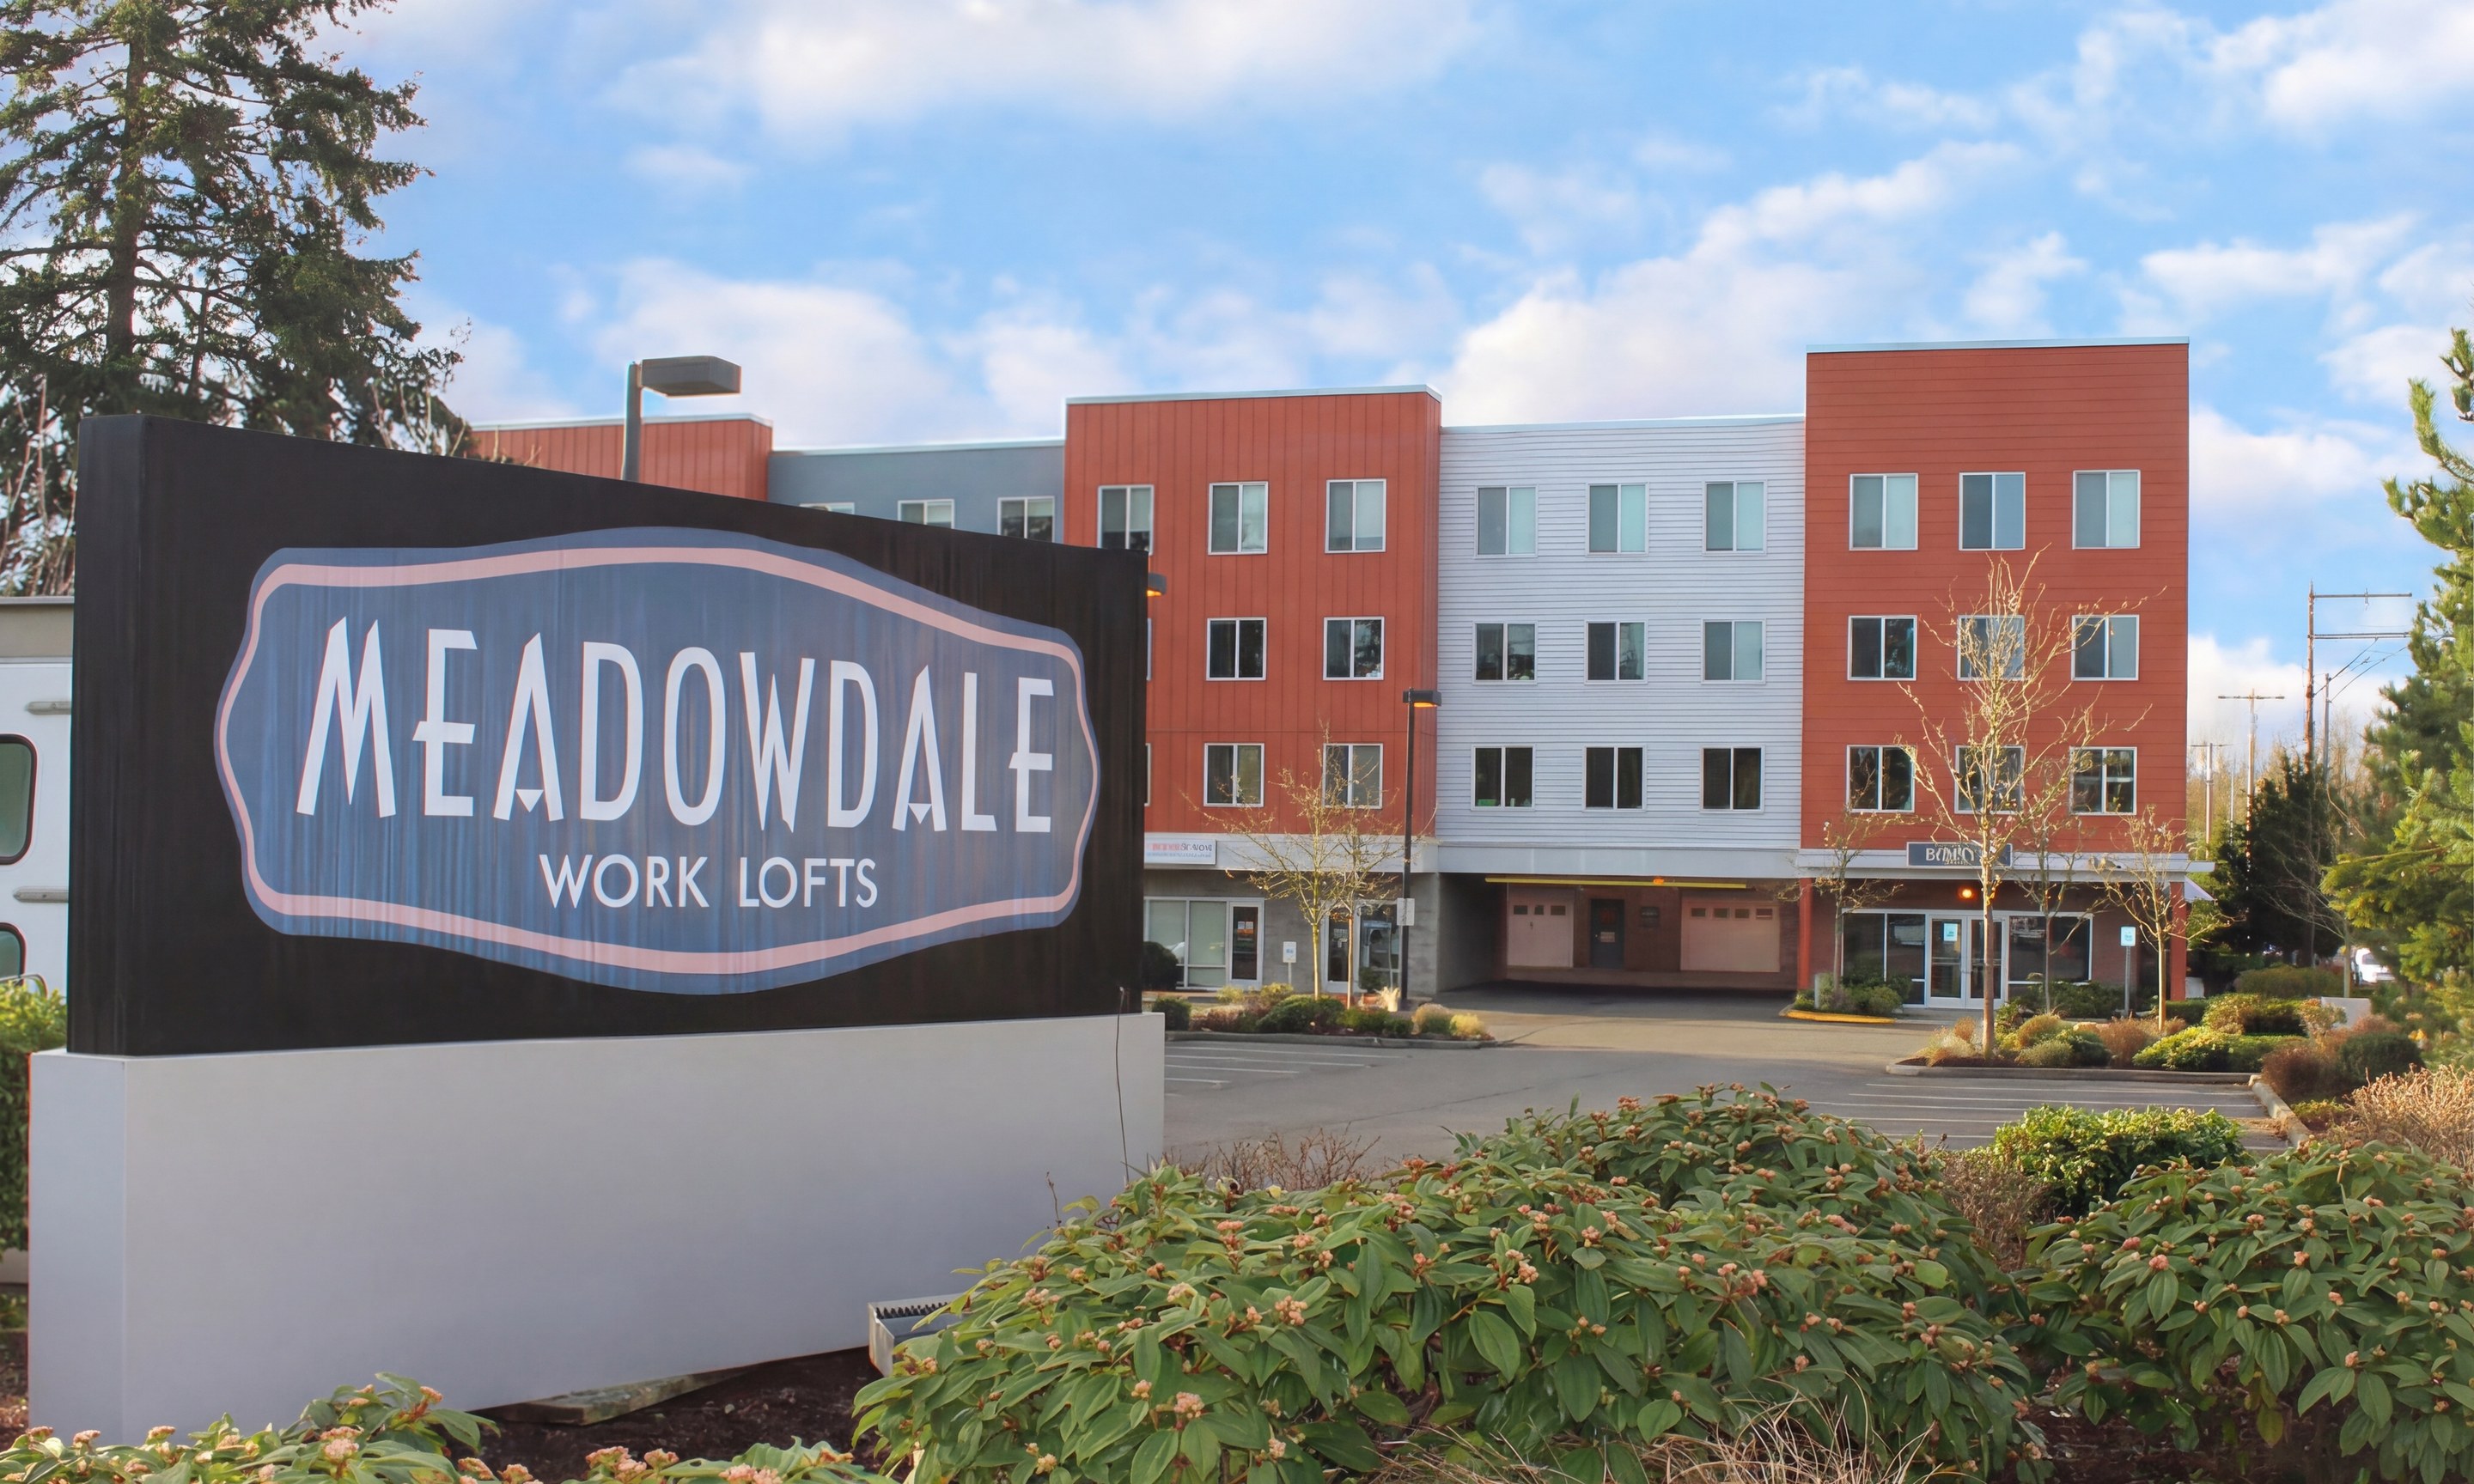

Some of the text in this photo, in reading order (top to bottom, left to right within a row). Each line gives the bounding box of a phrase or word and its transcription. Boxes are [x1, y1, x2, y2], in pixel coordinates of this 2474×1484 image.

[296, 616, 1055, 834] MEADOWDALE
[539, 853, 879, 909] WORK LOFTS
